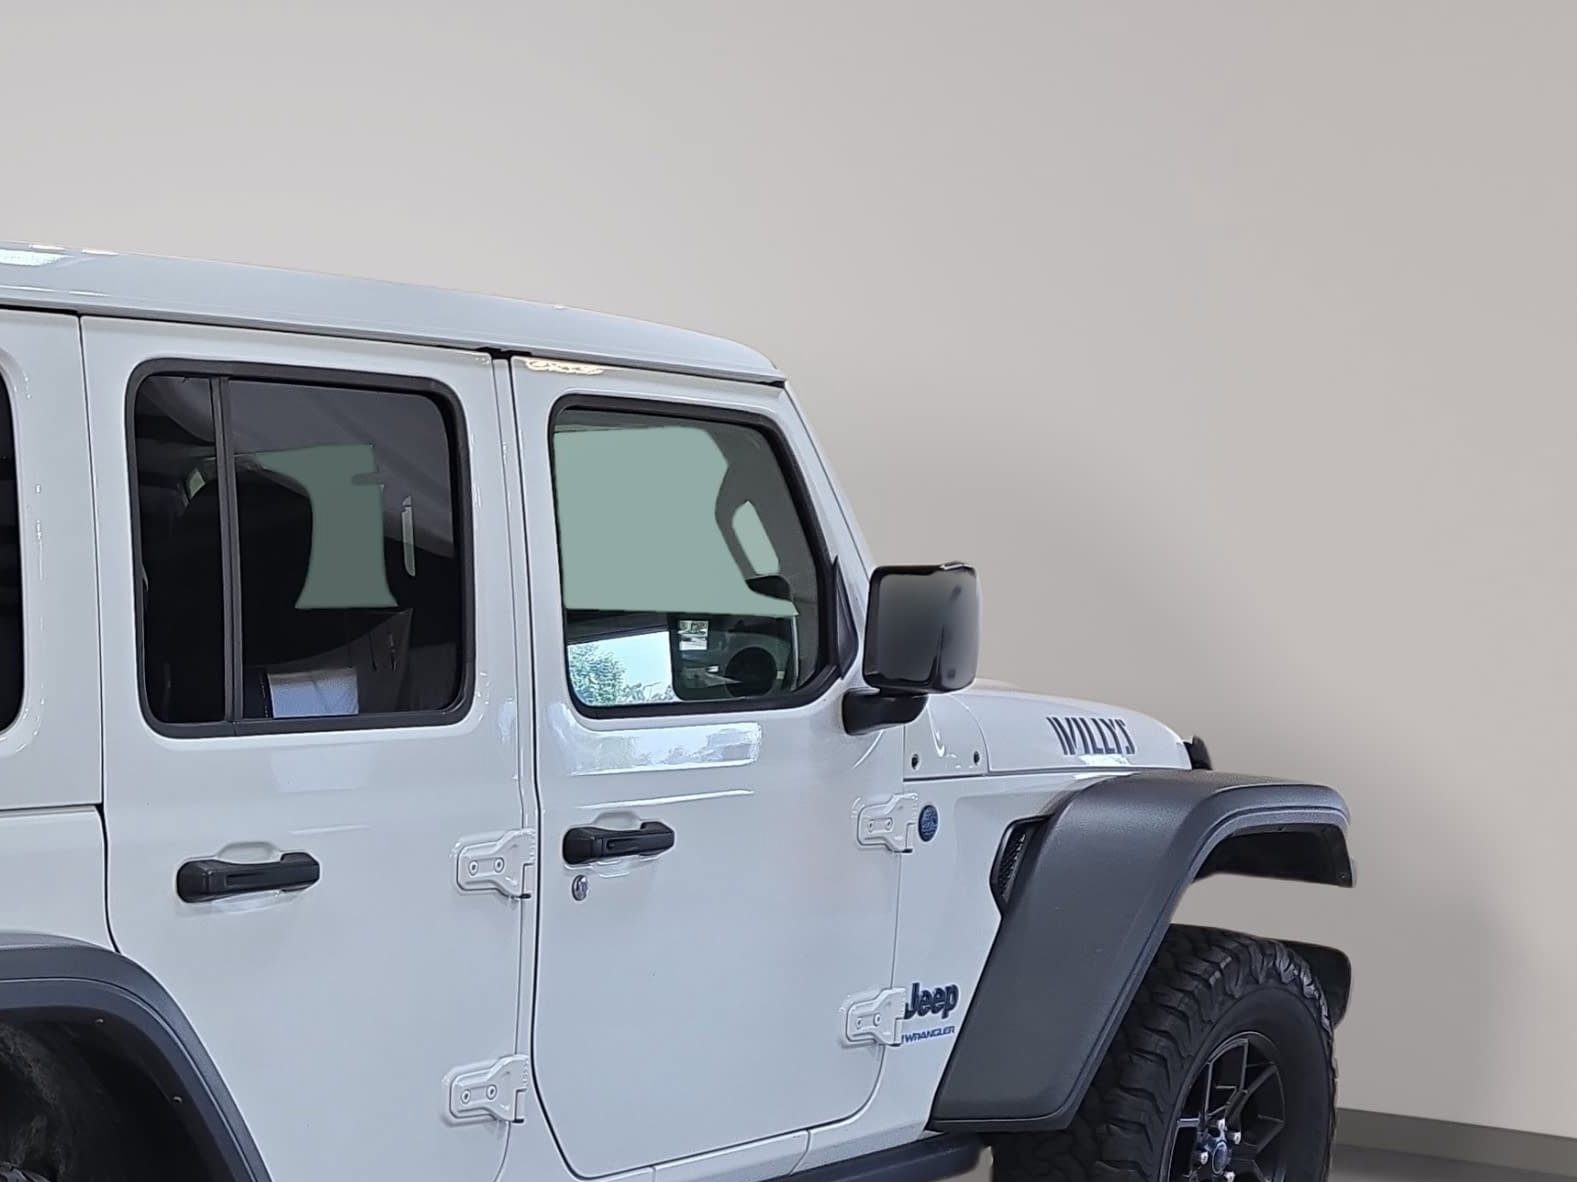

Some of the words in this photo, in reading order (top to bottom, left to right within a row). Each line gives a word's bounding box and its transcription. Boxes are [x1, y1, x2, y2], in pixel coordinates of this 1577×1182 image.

[1045, 716, 1136, 756] WILLYS
[904, 982, 959, 1020] Jeep
[904, 1025, 956, 1043] WRANGLER
